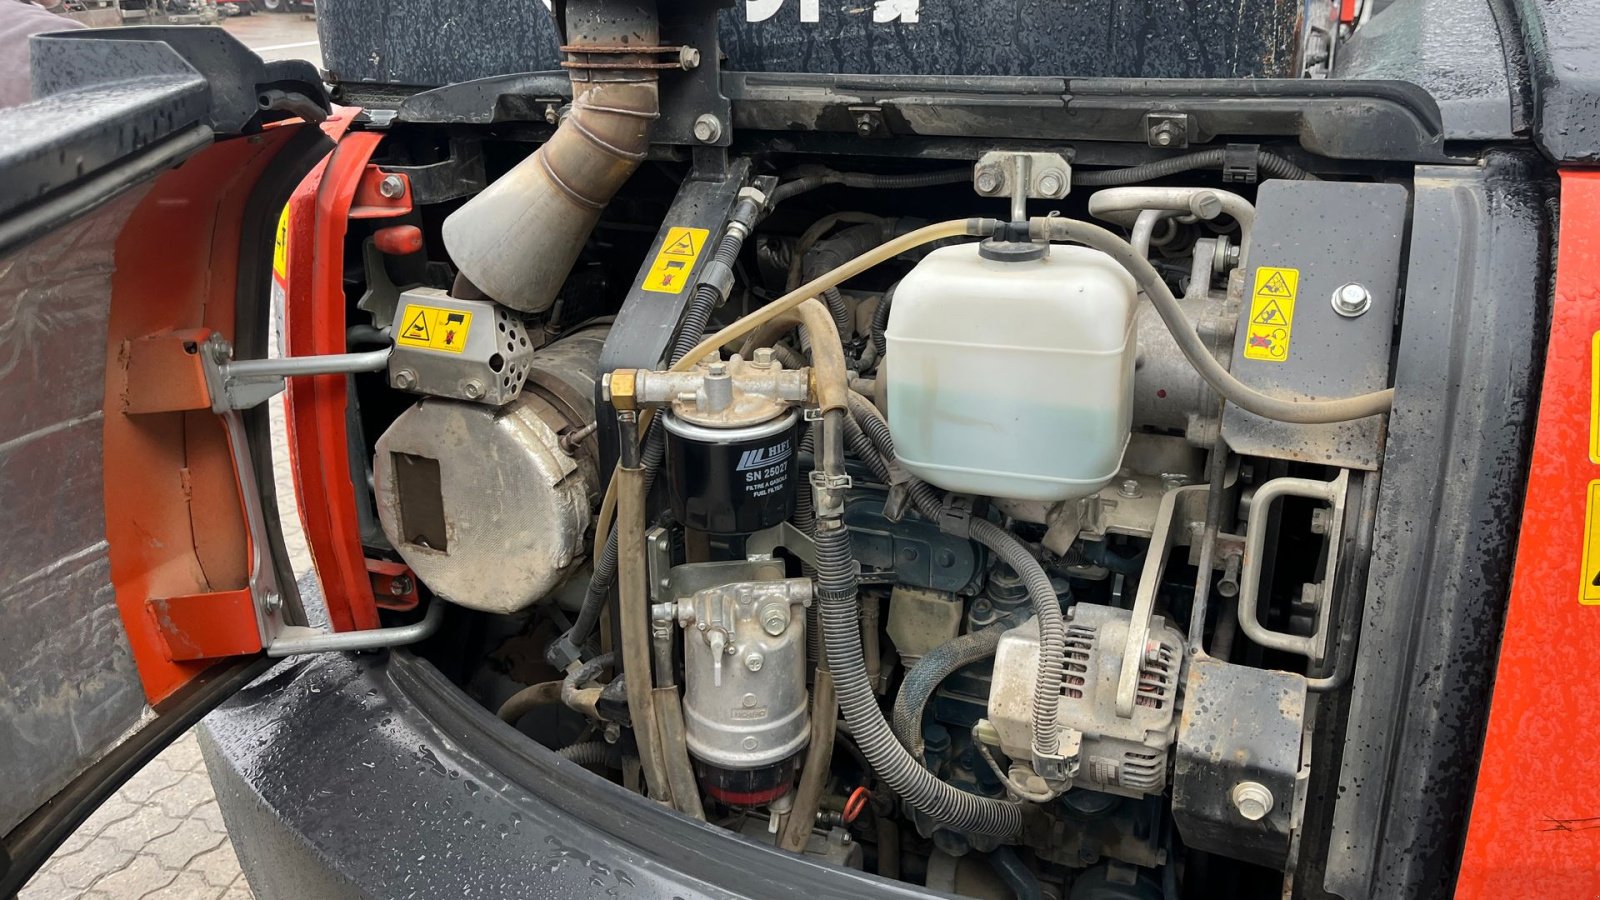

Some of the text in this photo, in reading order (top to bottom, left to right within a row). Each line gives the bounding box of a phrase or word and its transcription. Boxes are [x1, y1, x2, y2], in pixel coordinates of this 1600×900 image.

[745, 461, 788, 482] SN 25027
[745, 483, 765, 491] FILTRE
[753, 484, 784, 498] FUEL FILTER
